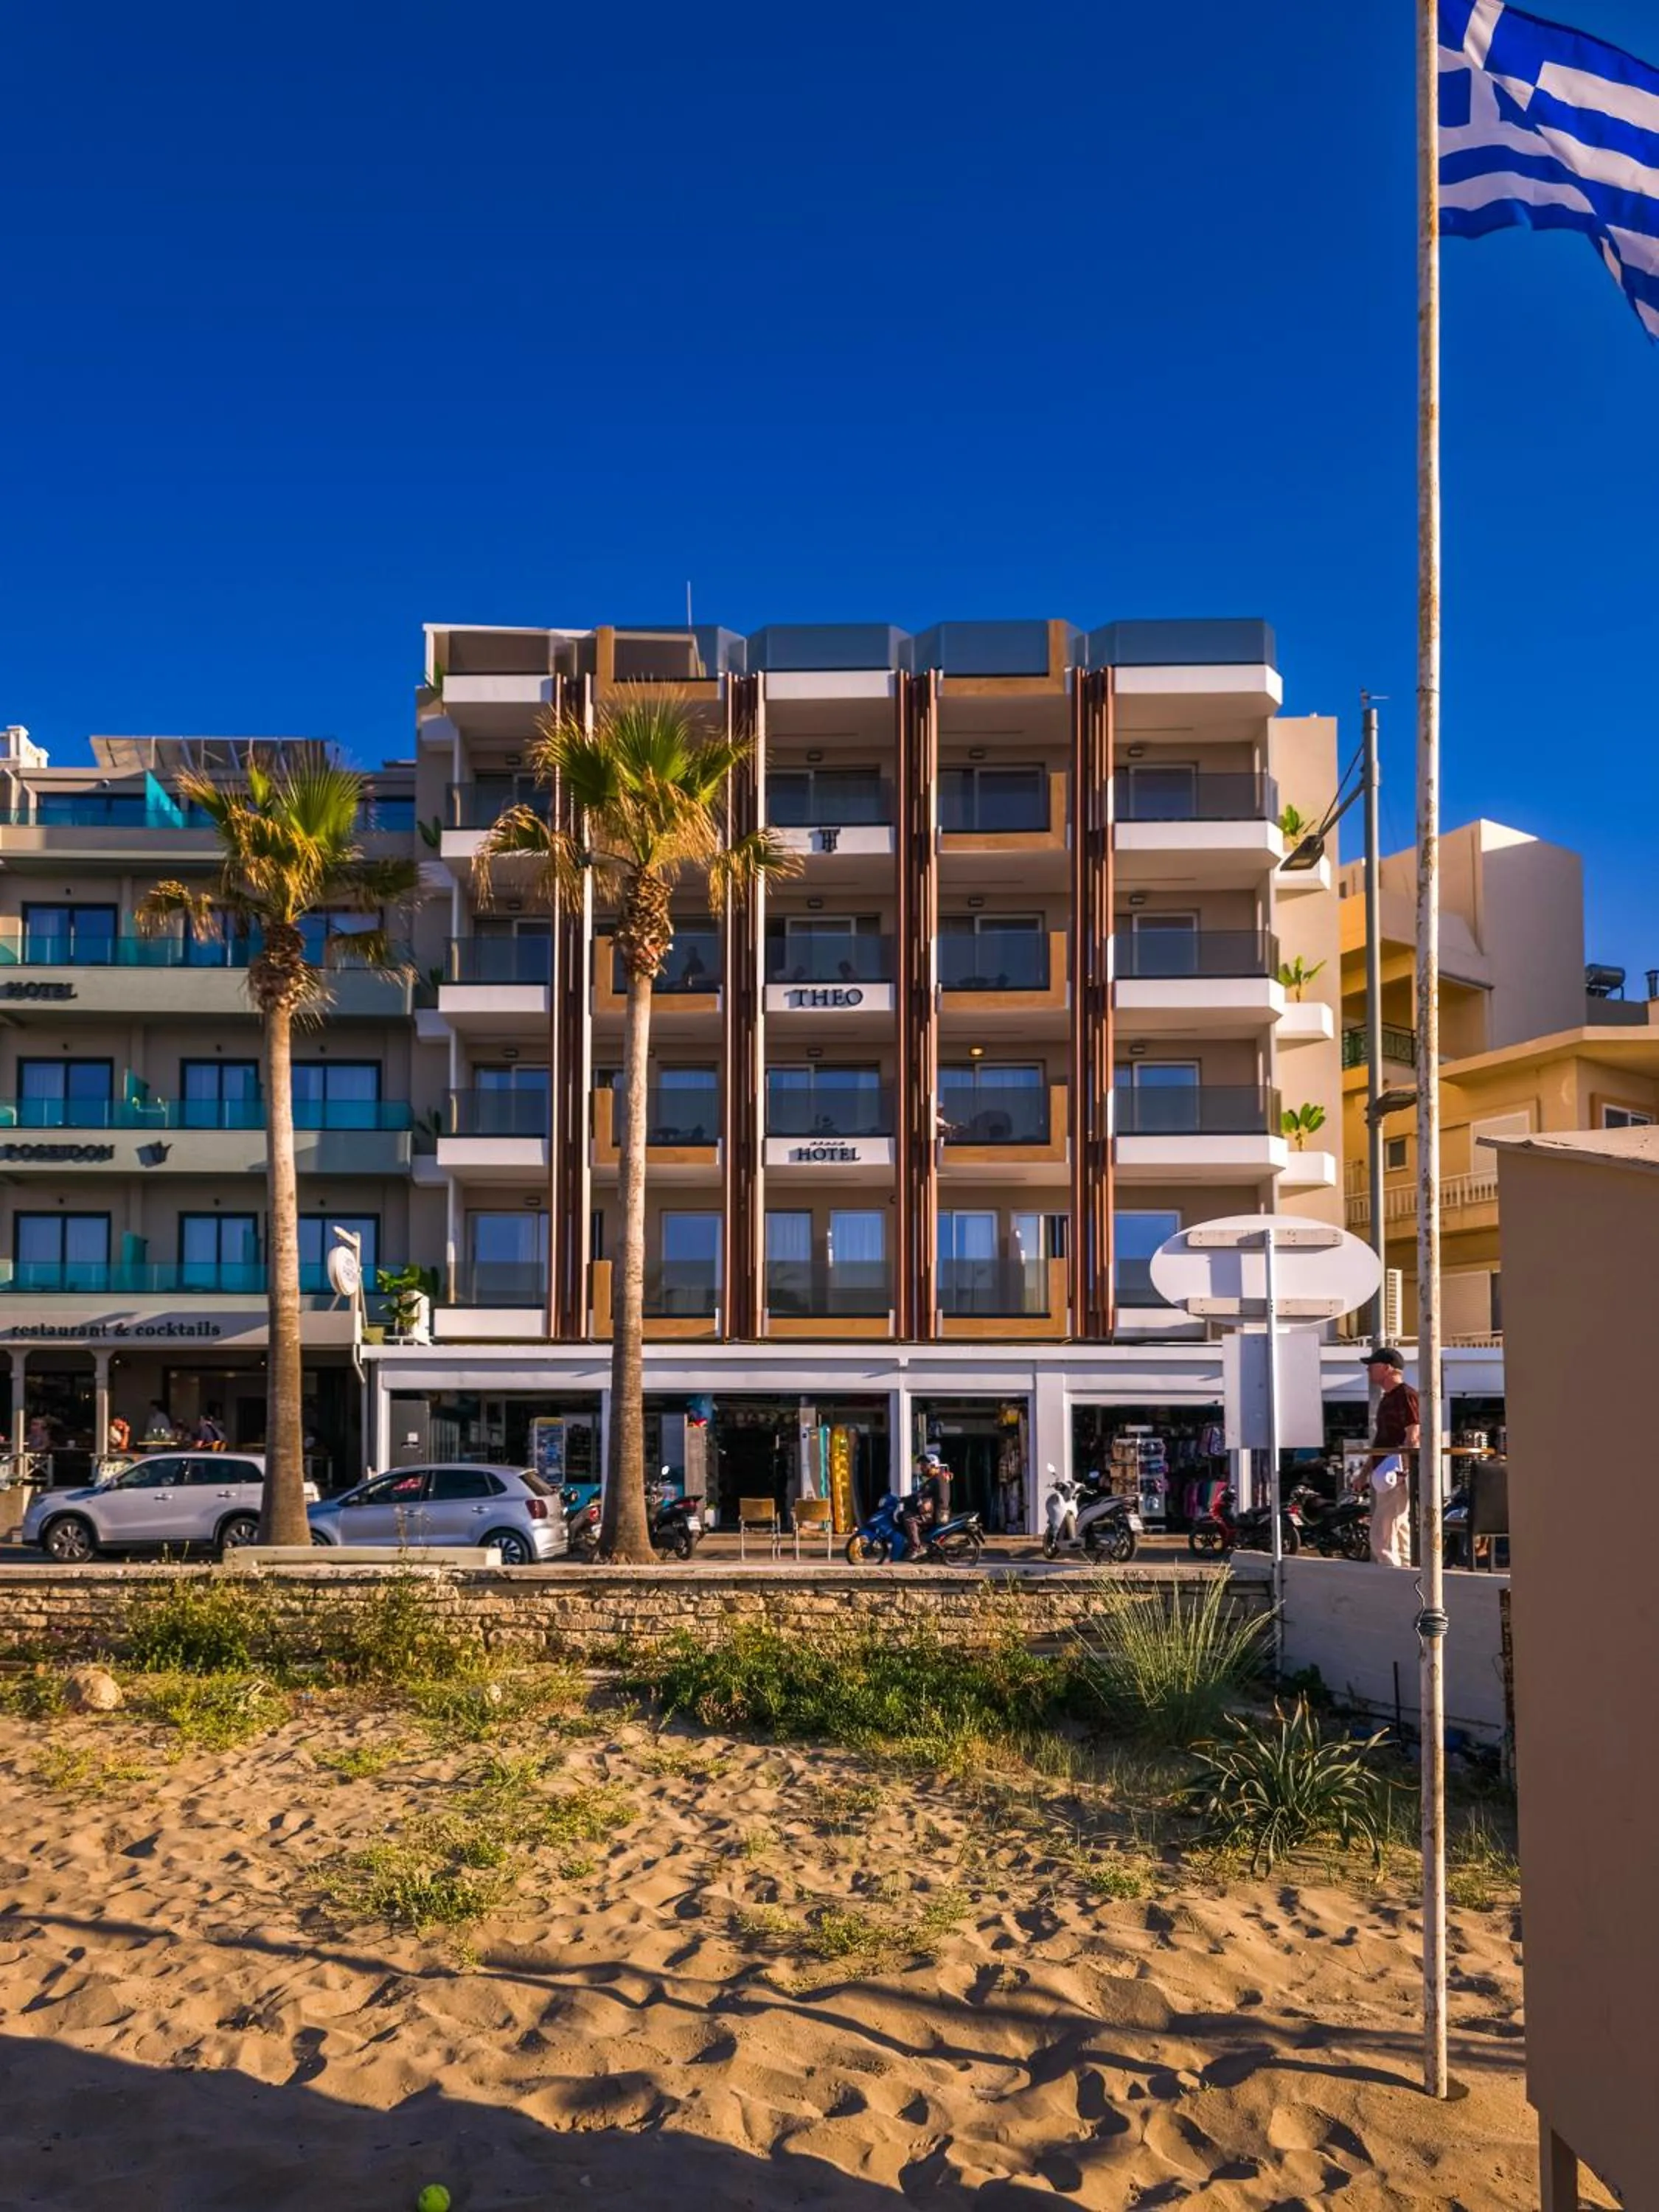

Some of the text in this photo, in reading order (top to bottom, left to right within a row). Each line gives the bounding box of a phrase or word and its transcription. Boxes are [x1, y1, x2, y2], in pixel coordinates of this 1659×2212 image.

[790, 989, 863, 1006] THEO
[797, 1147, 861, 1161] HOTEL
[11, 1321, 220, 1337] restaurant & cocktails
